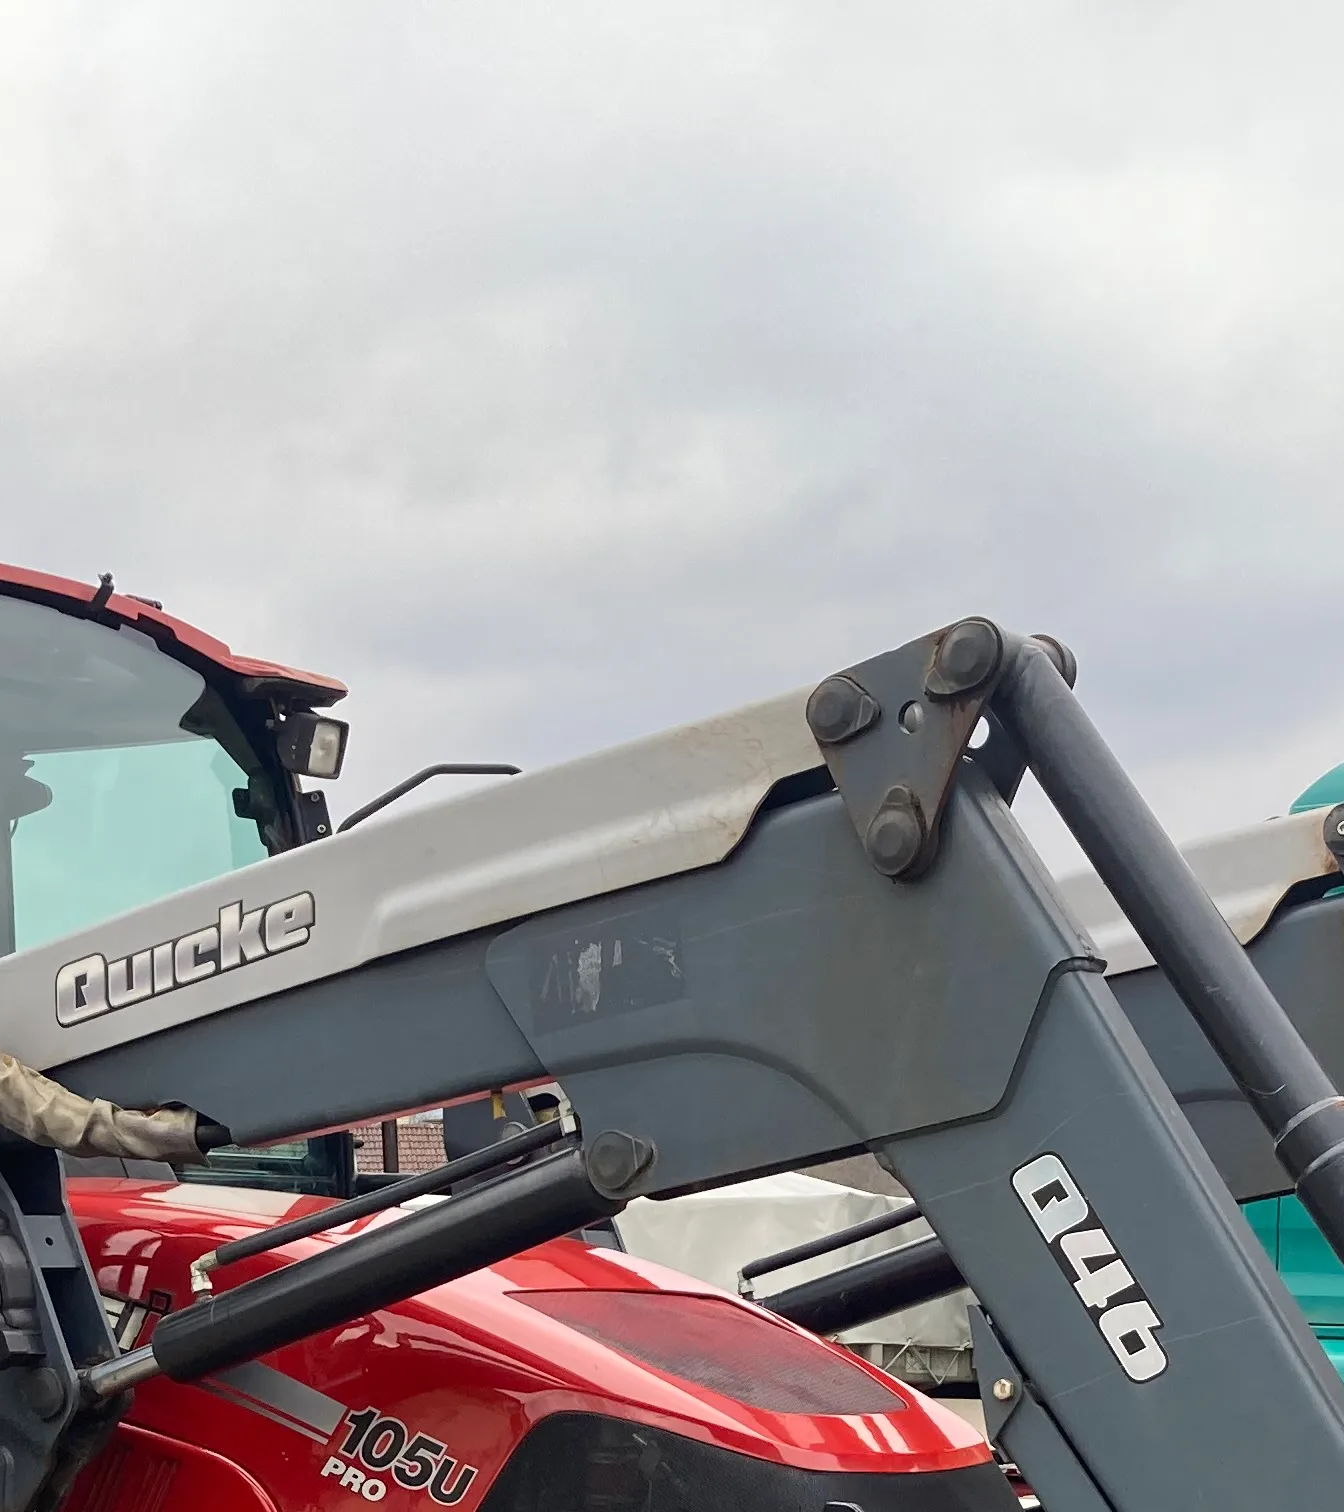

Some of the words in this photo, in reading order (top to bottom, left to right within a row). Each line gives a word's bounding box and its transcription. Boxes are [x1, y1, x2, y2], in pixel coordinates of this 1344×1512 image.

[55, 890, 316, 1028] Quicke
[1009, 1150, 1169, 1385] Q46
[320, 1456, 387, 1502] PRO
[338, 1405, 479, 1507] 105U
